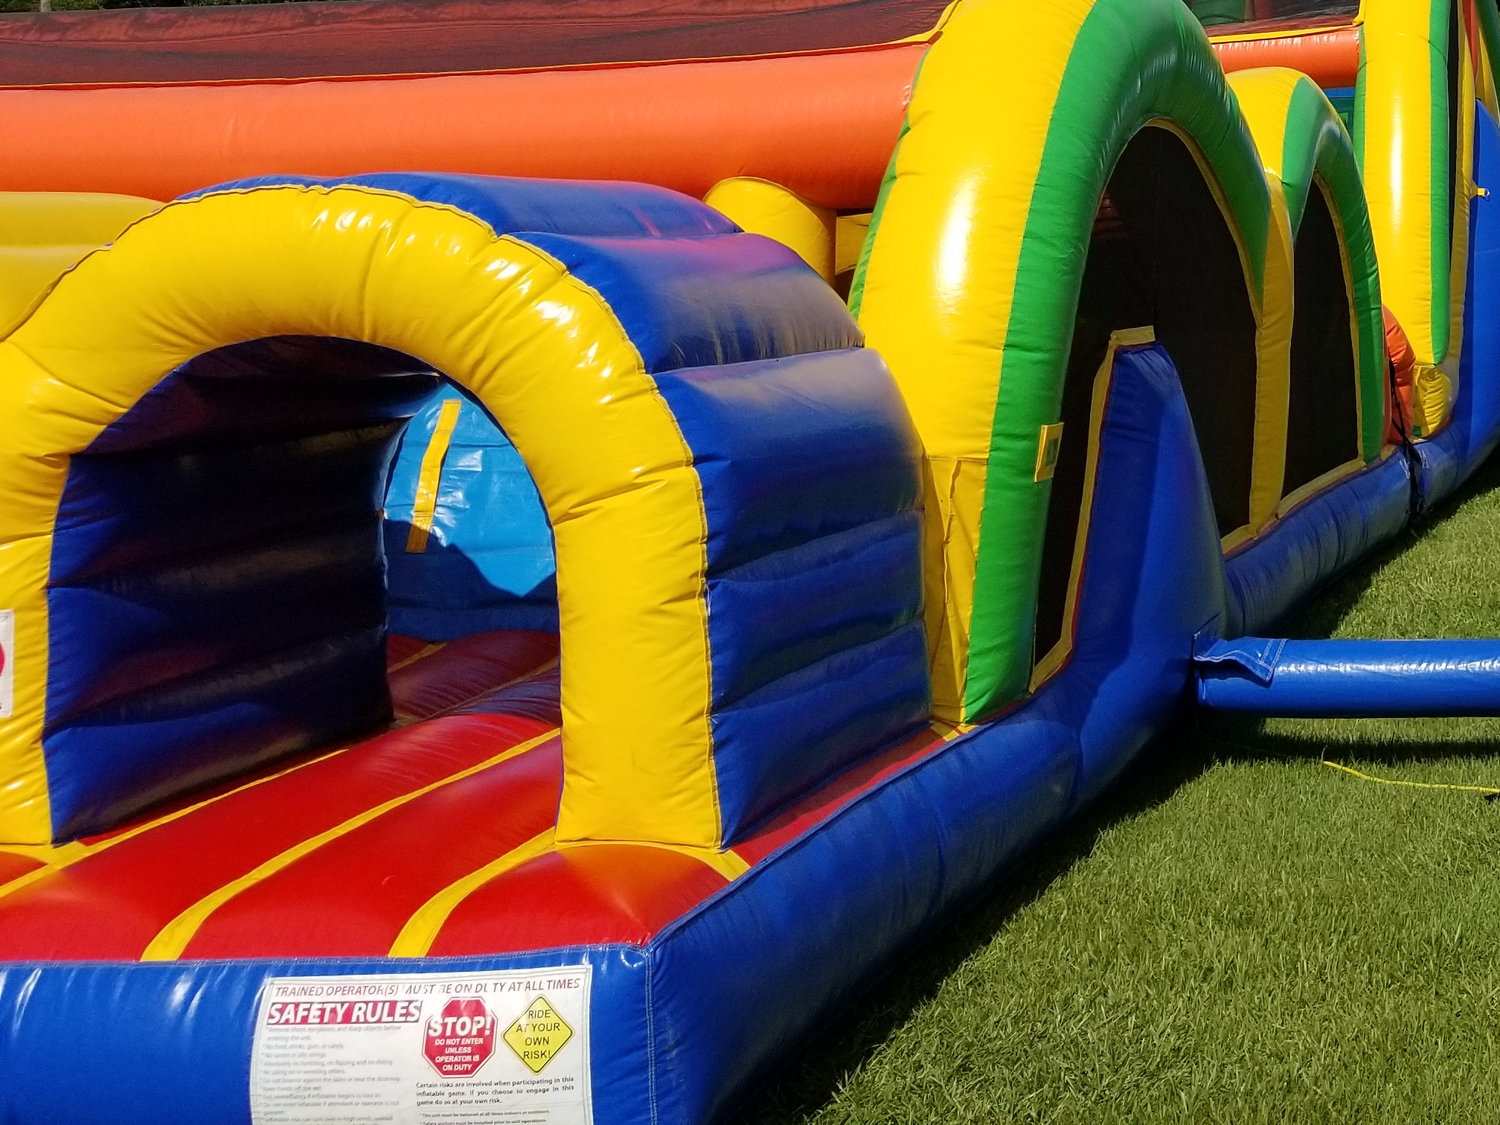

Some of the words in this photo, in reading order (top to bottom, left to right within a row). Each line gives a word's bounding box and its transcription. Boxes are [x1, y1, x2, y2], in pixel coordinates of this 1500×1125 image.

[275, 986, 323, 997] TRAINED
[326, 984, 399, 996] OPERATOR(S)
[454, 983, 473, 993] ON
[508, 981, 523, 992] AT
[524, 980, 544, 991] ALL
[547, 978, 580, 990] TIMES
[268, 1002, 350, 1024] SAFETY
[351, 1000, 422, 1023] RULES
[528, 1009, 551, 1019] RIDE
[428, 1015, 493, 1037] STOP!
[516, 1023, 529, 1033] AT
[531, 1022, 561, 1033] YOUR
[461, 1037, 484, 1045] ENTER
[524, 1036, 550, 1046] OWN
[523, 1049, 551, 1060] RISK!
[454, 1063, 473, 1071] DUTY
[512, 1078, 553, 1087] participating
[460, 1098, 474, 1106] your
